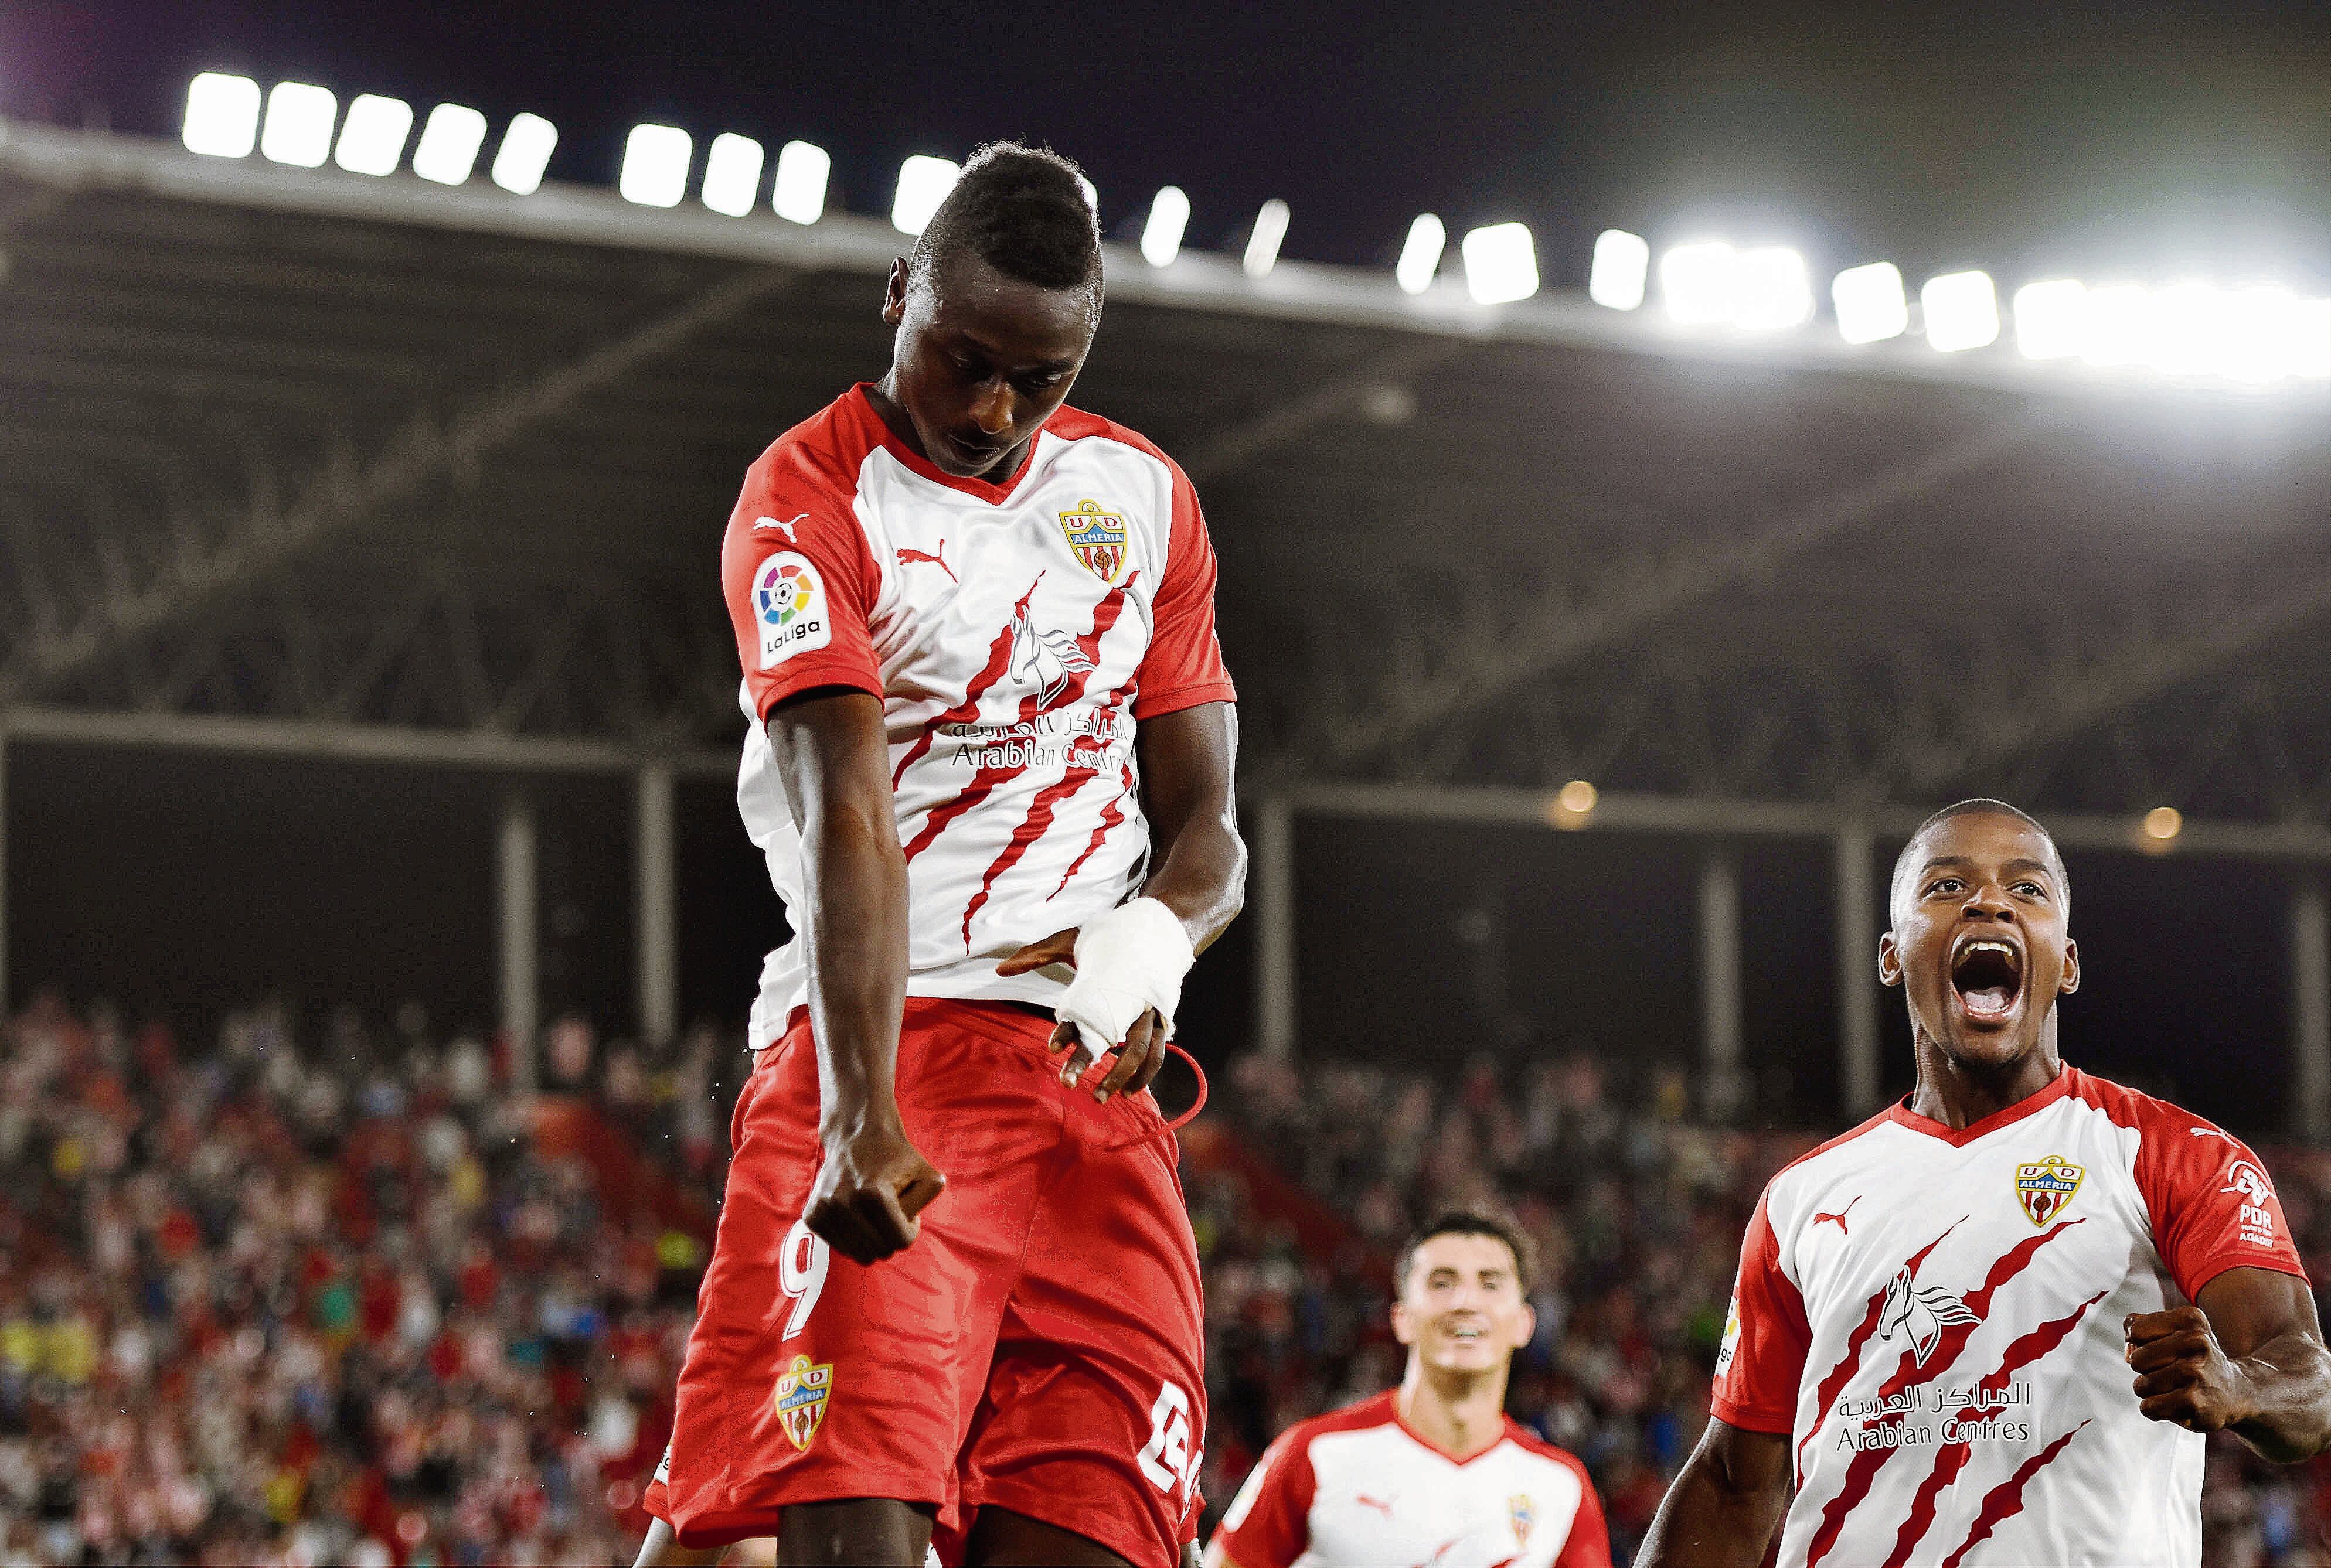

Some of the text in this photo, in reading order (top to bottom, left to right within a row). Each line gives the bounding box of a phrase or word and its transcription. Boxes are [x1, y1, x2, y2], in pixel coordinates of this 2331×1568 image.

[1070, 517, 1117, 527] U D
[1074, 533, 1122, 544] ALMERIA
[768, 621, 821, 654] LaLiga
[952, 741, 1122, 772] Arabian Centr
[2020, 1180, 2073, 1191] ALMERIA
[2061, 1168, 2075, 1177] D
[2239, 1204, 2274, 1230] PDR
[780, 1219, 830, 1343] 9
[1839, 1383, 2030, 1421] المراكز العربية
[1837, 1418, 2029, 1451] Arabian Centres
